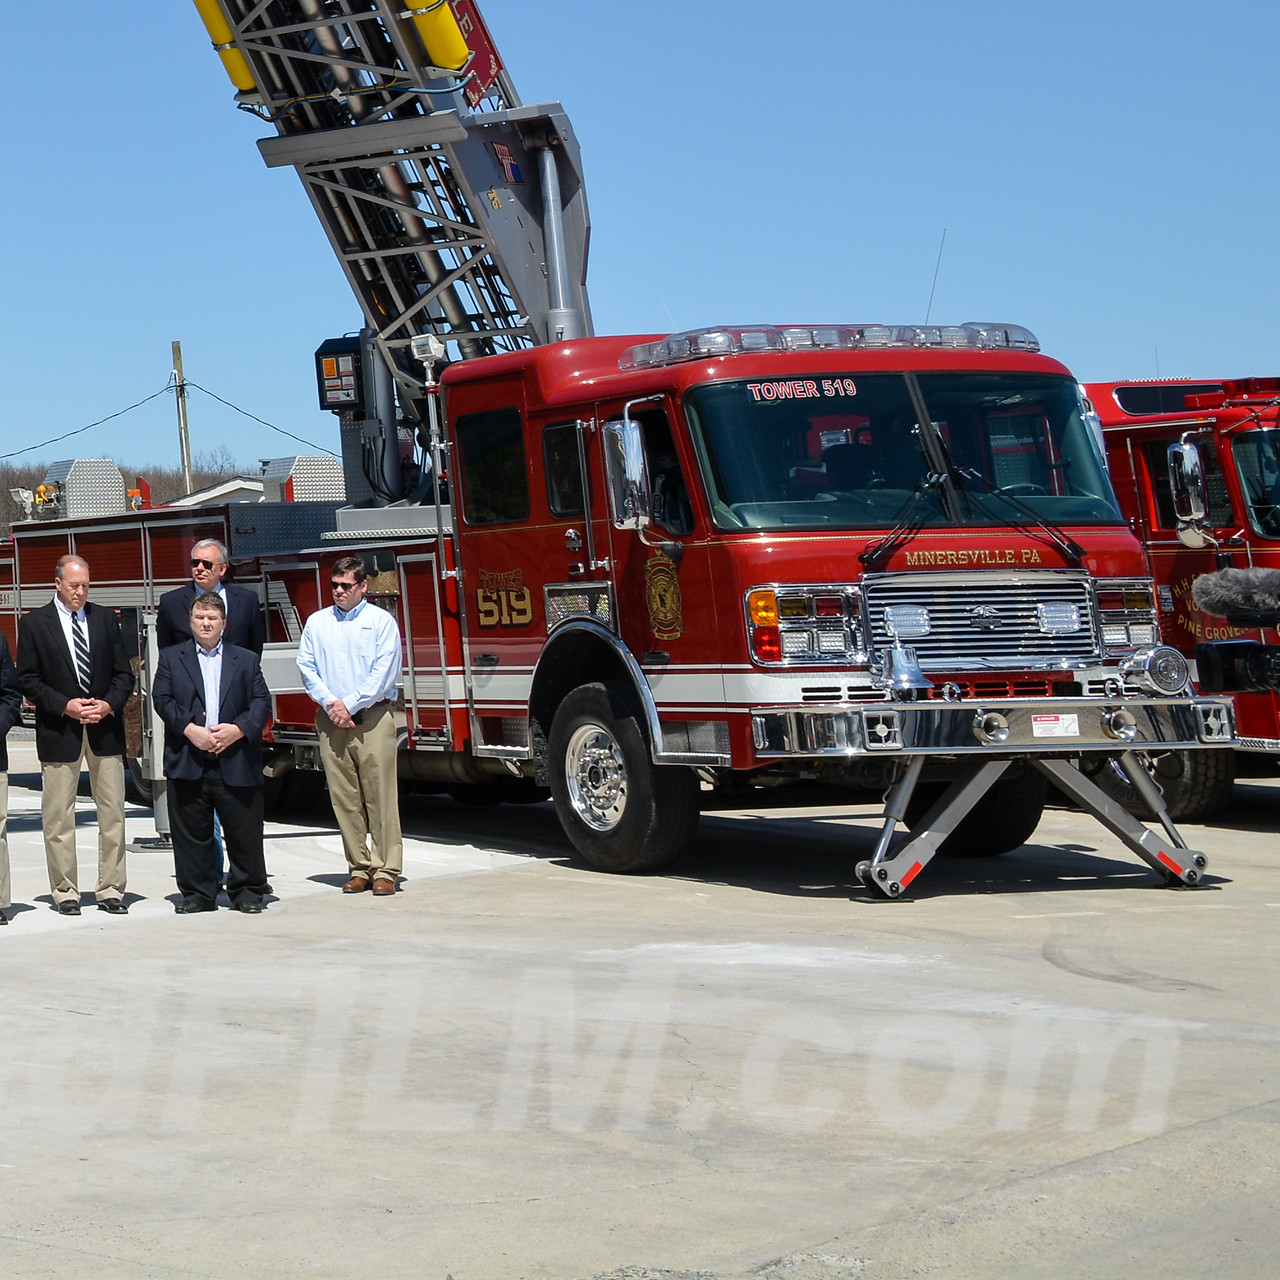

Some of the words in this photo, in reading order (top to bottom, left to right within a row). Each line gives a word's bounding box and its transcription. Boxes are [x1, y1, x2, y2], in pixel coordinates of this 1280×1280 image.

[747, 380, 821, 401] TOWER
[821, 378, 857, 397] 519
[1021, 548, 1042, 564] PA
[478, 568, 523, 596] TOWER
[476, 585, 533, 626] 519
[1178, 615, 1201, 637] PINE
